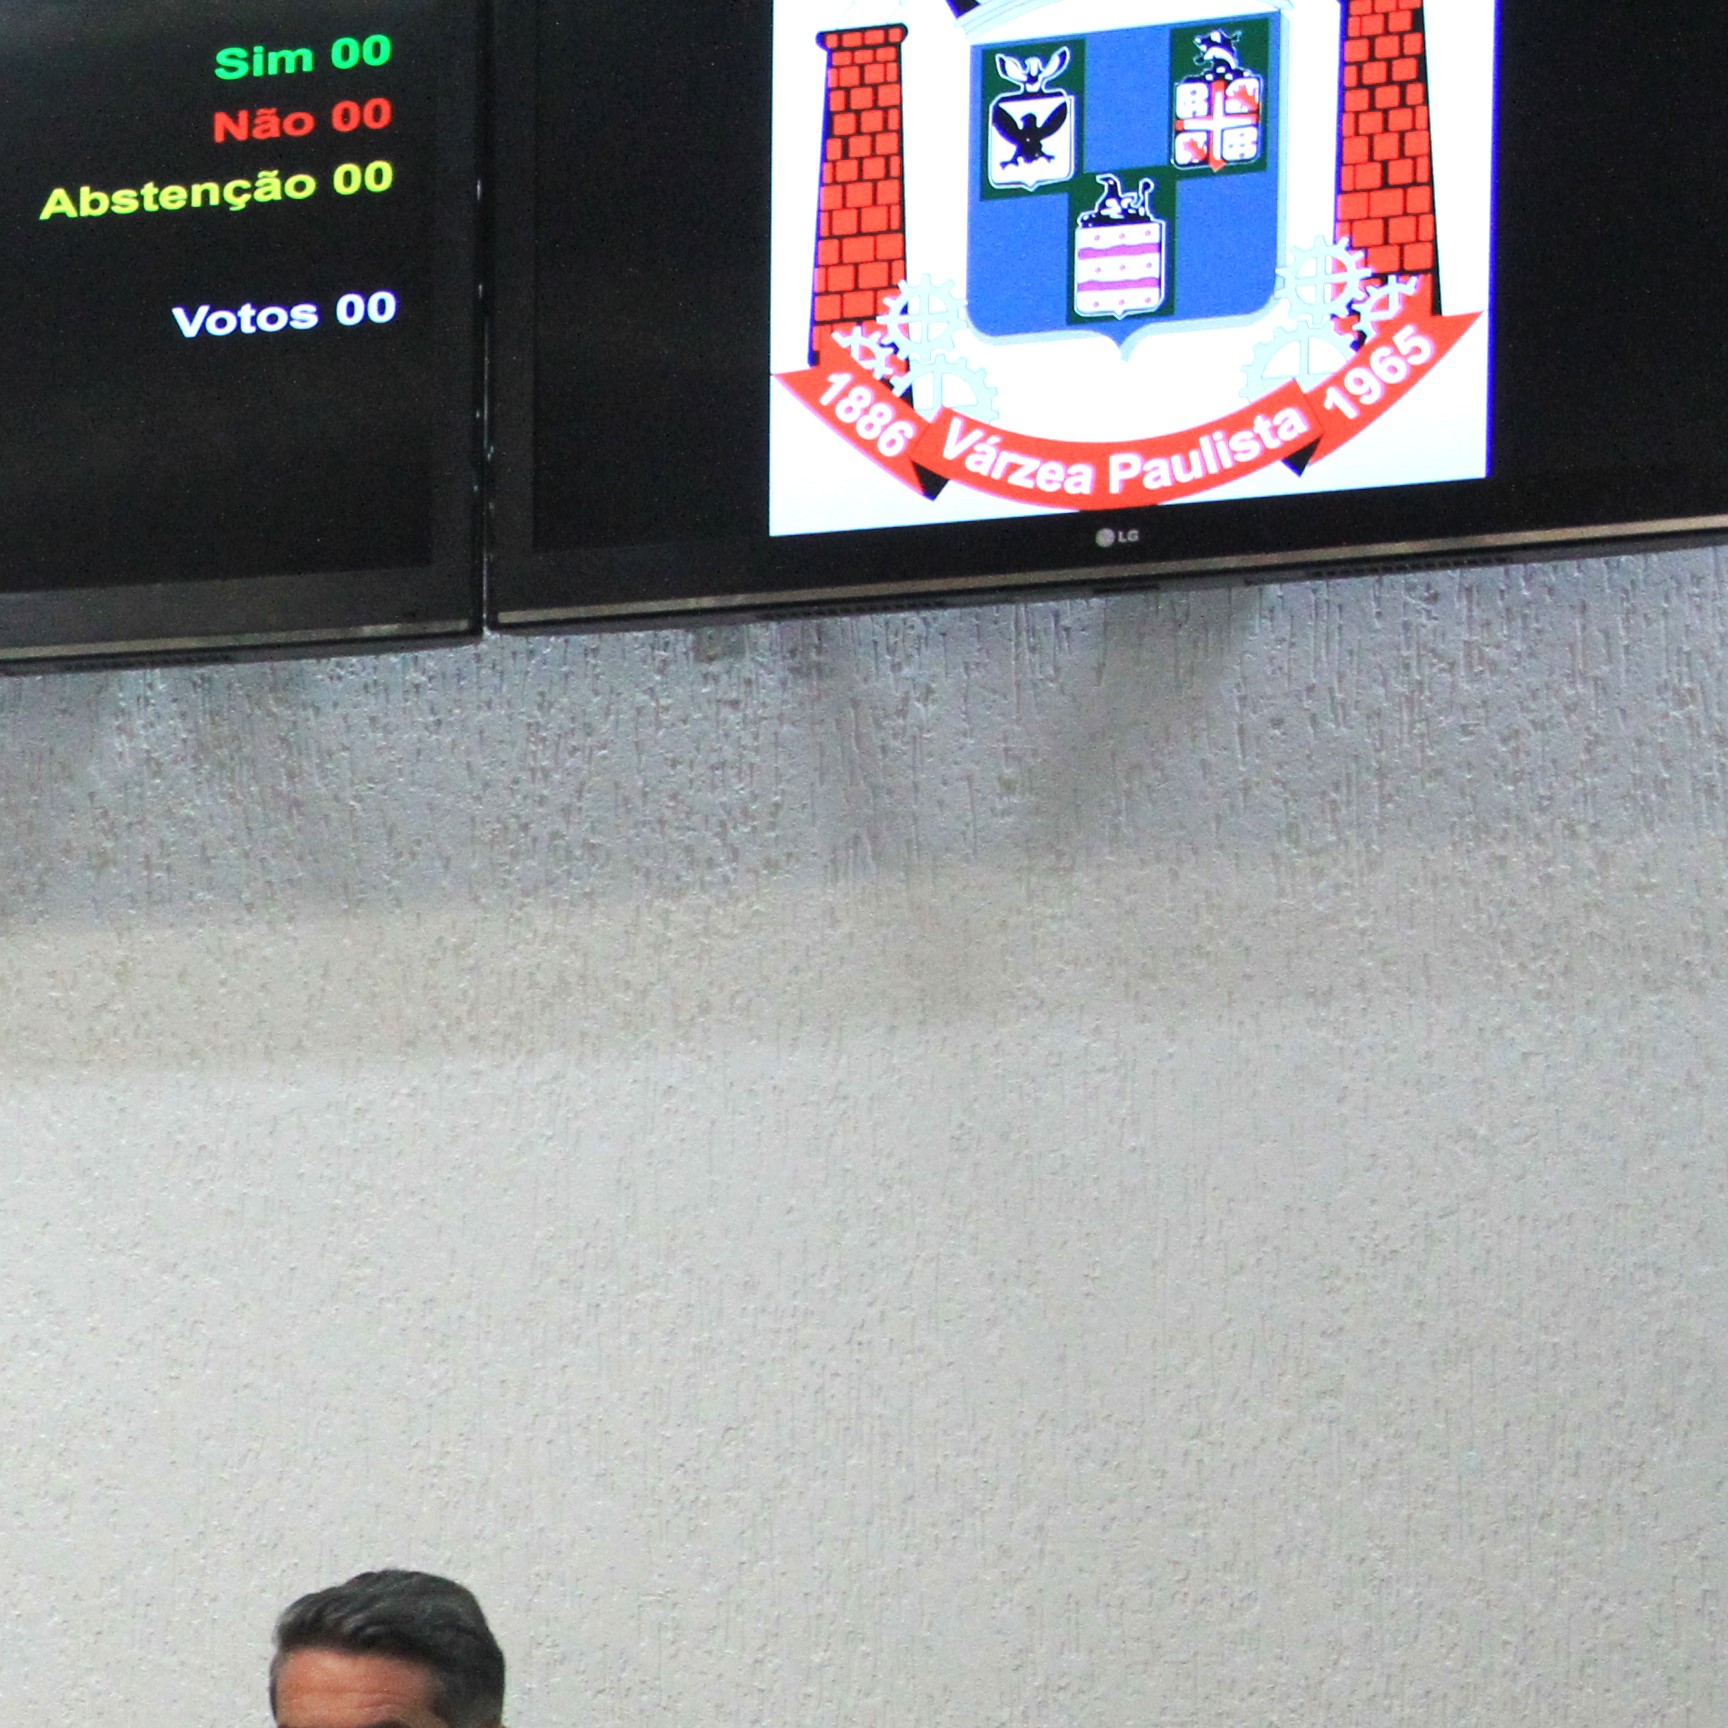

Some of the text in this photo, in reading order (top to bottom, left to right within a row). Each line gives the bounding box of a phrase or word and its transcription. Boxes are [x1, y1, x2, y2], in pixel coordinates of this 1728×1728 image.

[214, 33, 392, 81] Sim 00
[213, 97, 392, 144] Não 00
[38, 160, 394, 221] Abstenção 00
[171, 291, 397, 338] Votos 00
[1323, 324, 1434, 420] 1965
[818, 372, 914, 457] 1886
[943, 407, 1309, 495] Várzea Paulista
